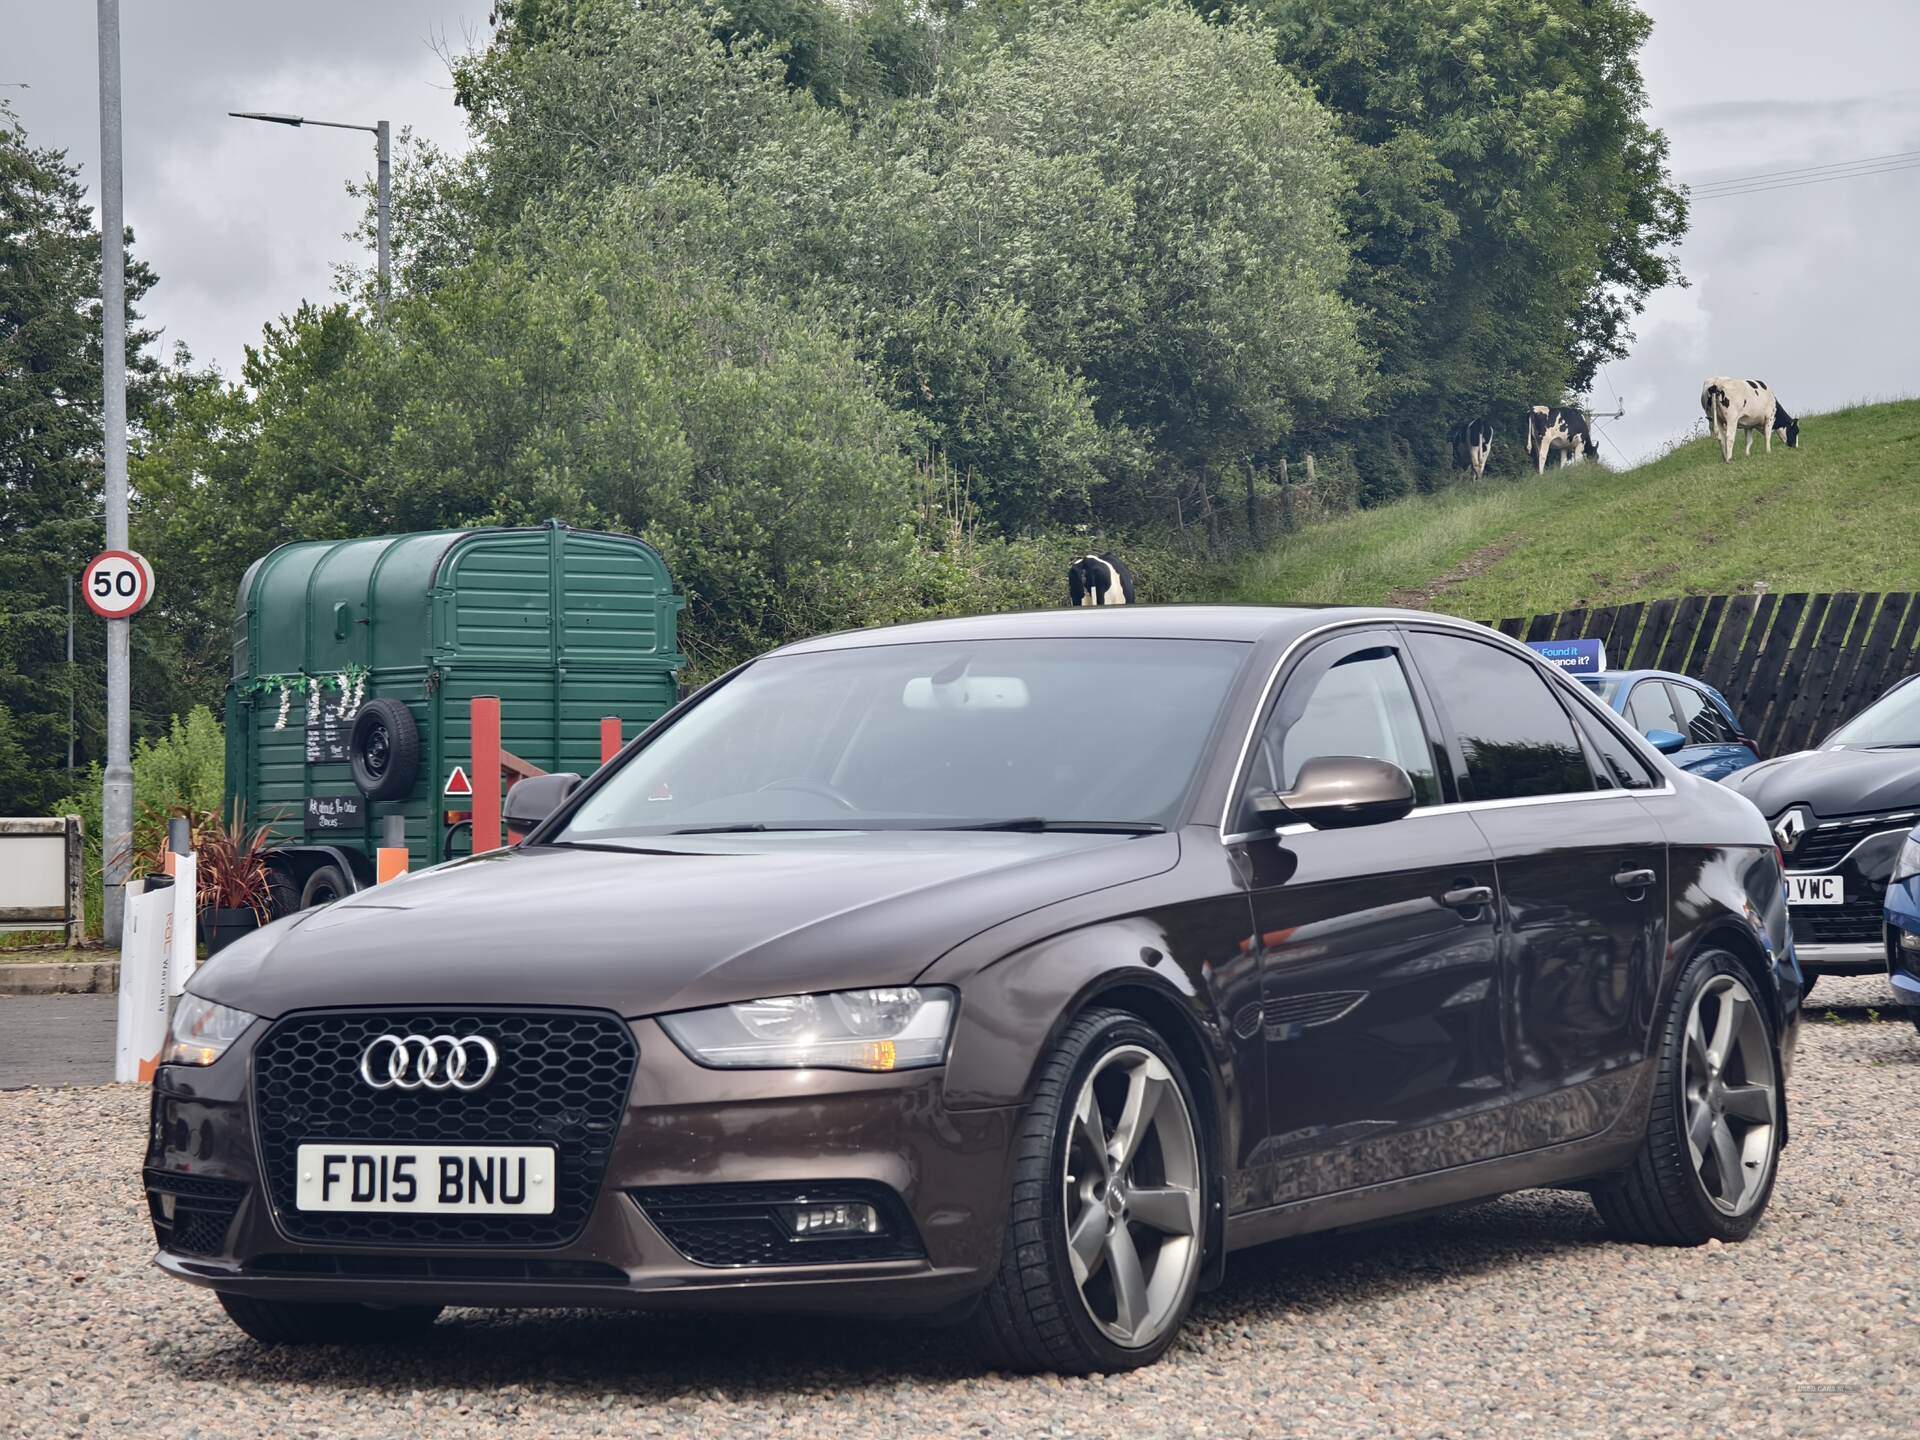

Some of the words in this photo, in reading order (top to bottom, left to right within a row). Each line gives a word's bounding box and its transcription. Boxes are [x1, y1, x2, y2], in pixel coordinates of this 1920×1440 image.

[94, 571, 136, 597] 50
[1542, 648, 1570, 656] Found
[1571, 647, 1578, 655] it
[1578, 656, 1590, 664] it?
[1797, 879, 1834, 899] VWC
[158, 959, 169, 1013] Warranty
[322, 1154, 417, 1204] FD15
[438, 1156, 526, 1205] BNU
